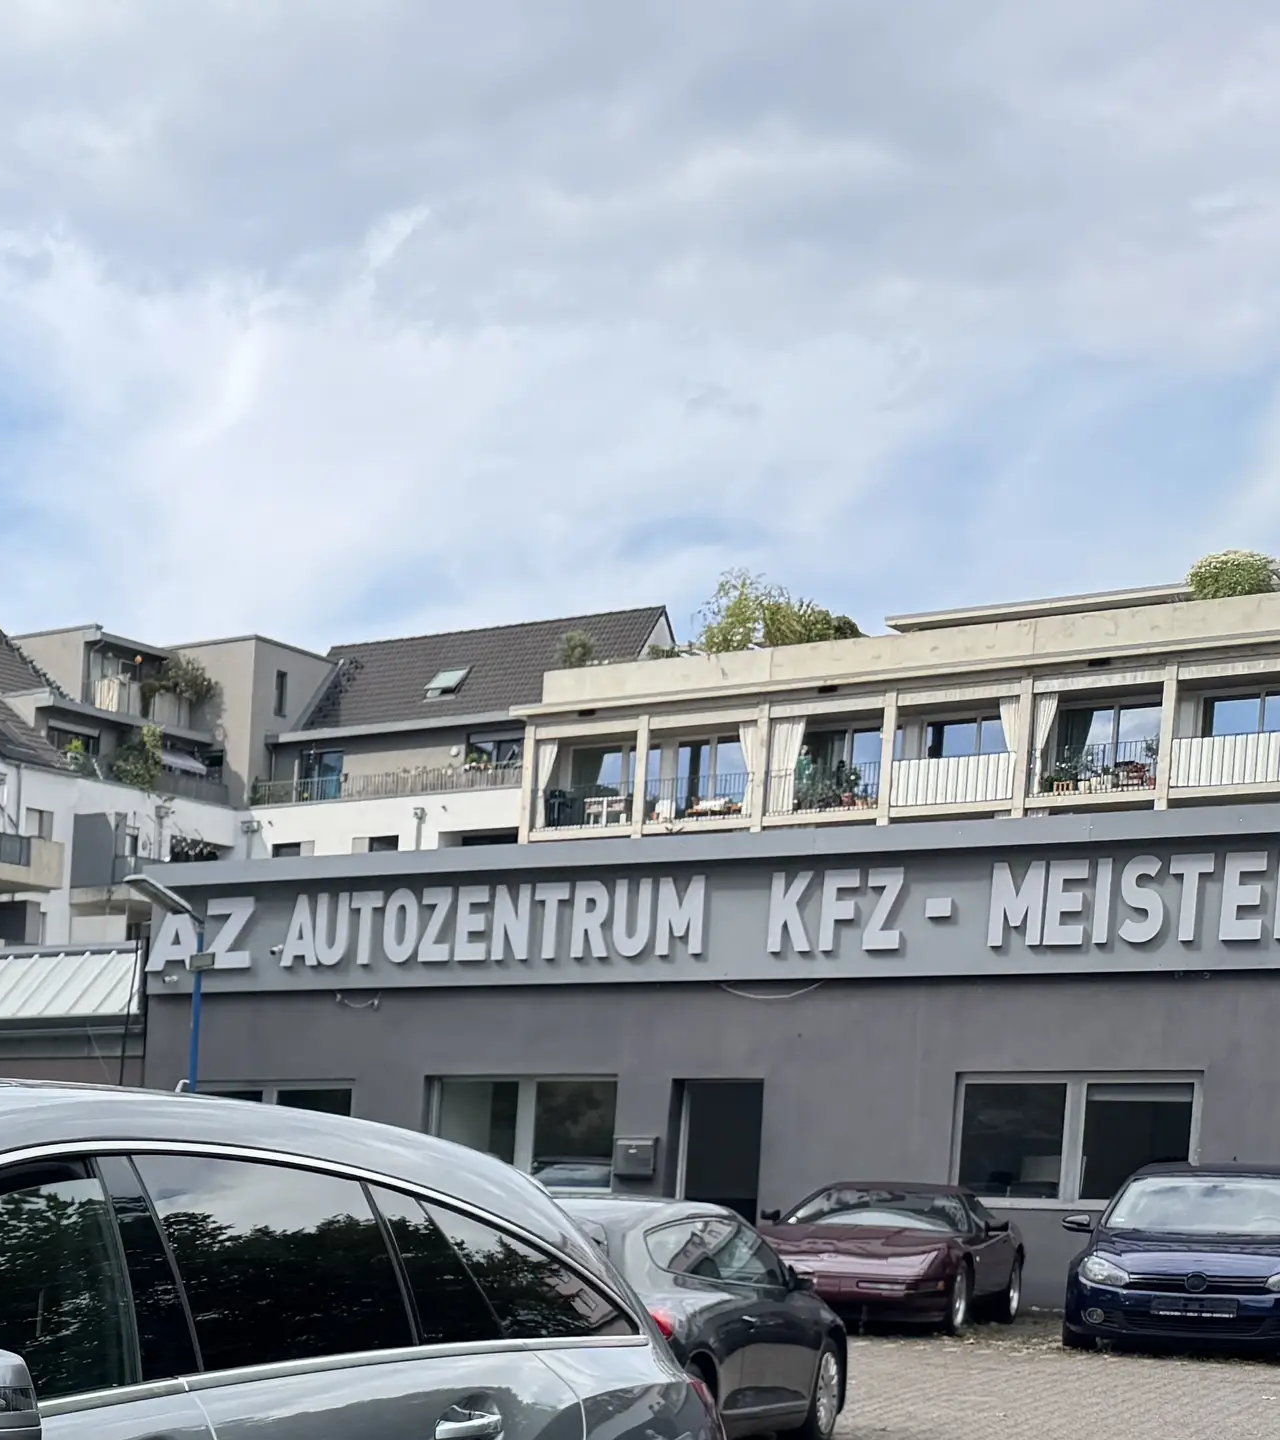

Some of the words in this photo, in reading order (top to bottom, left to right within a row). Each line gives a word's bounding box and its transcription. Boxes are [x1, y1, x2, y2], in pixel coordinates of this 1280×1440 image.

[145, 896, 255, 972] AZ
[280, 875, 706, 967] AUTOZENTRUM
[767, 867, 904, 953] KFZ
[987, 851, 1280, 947] MEISTE
